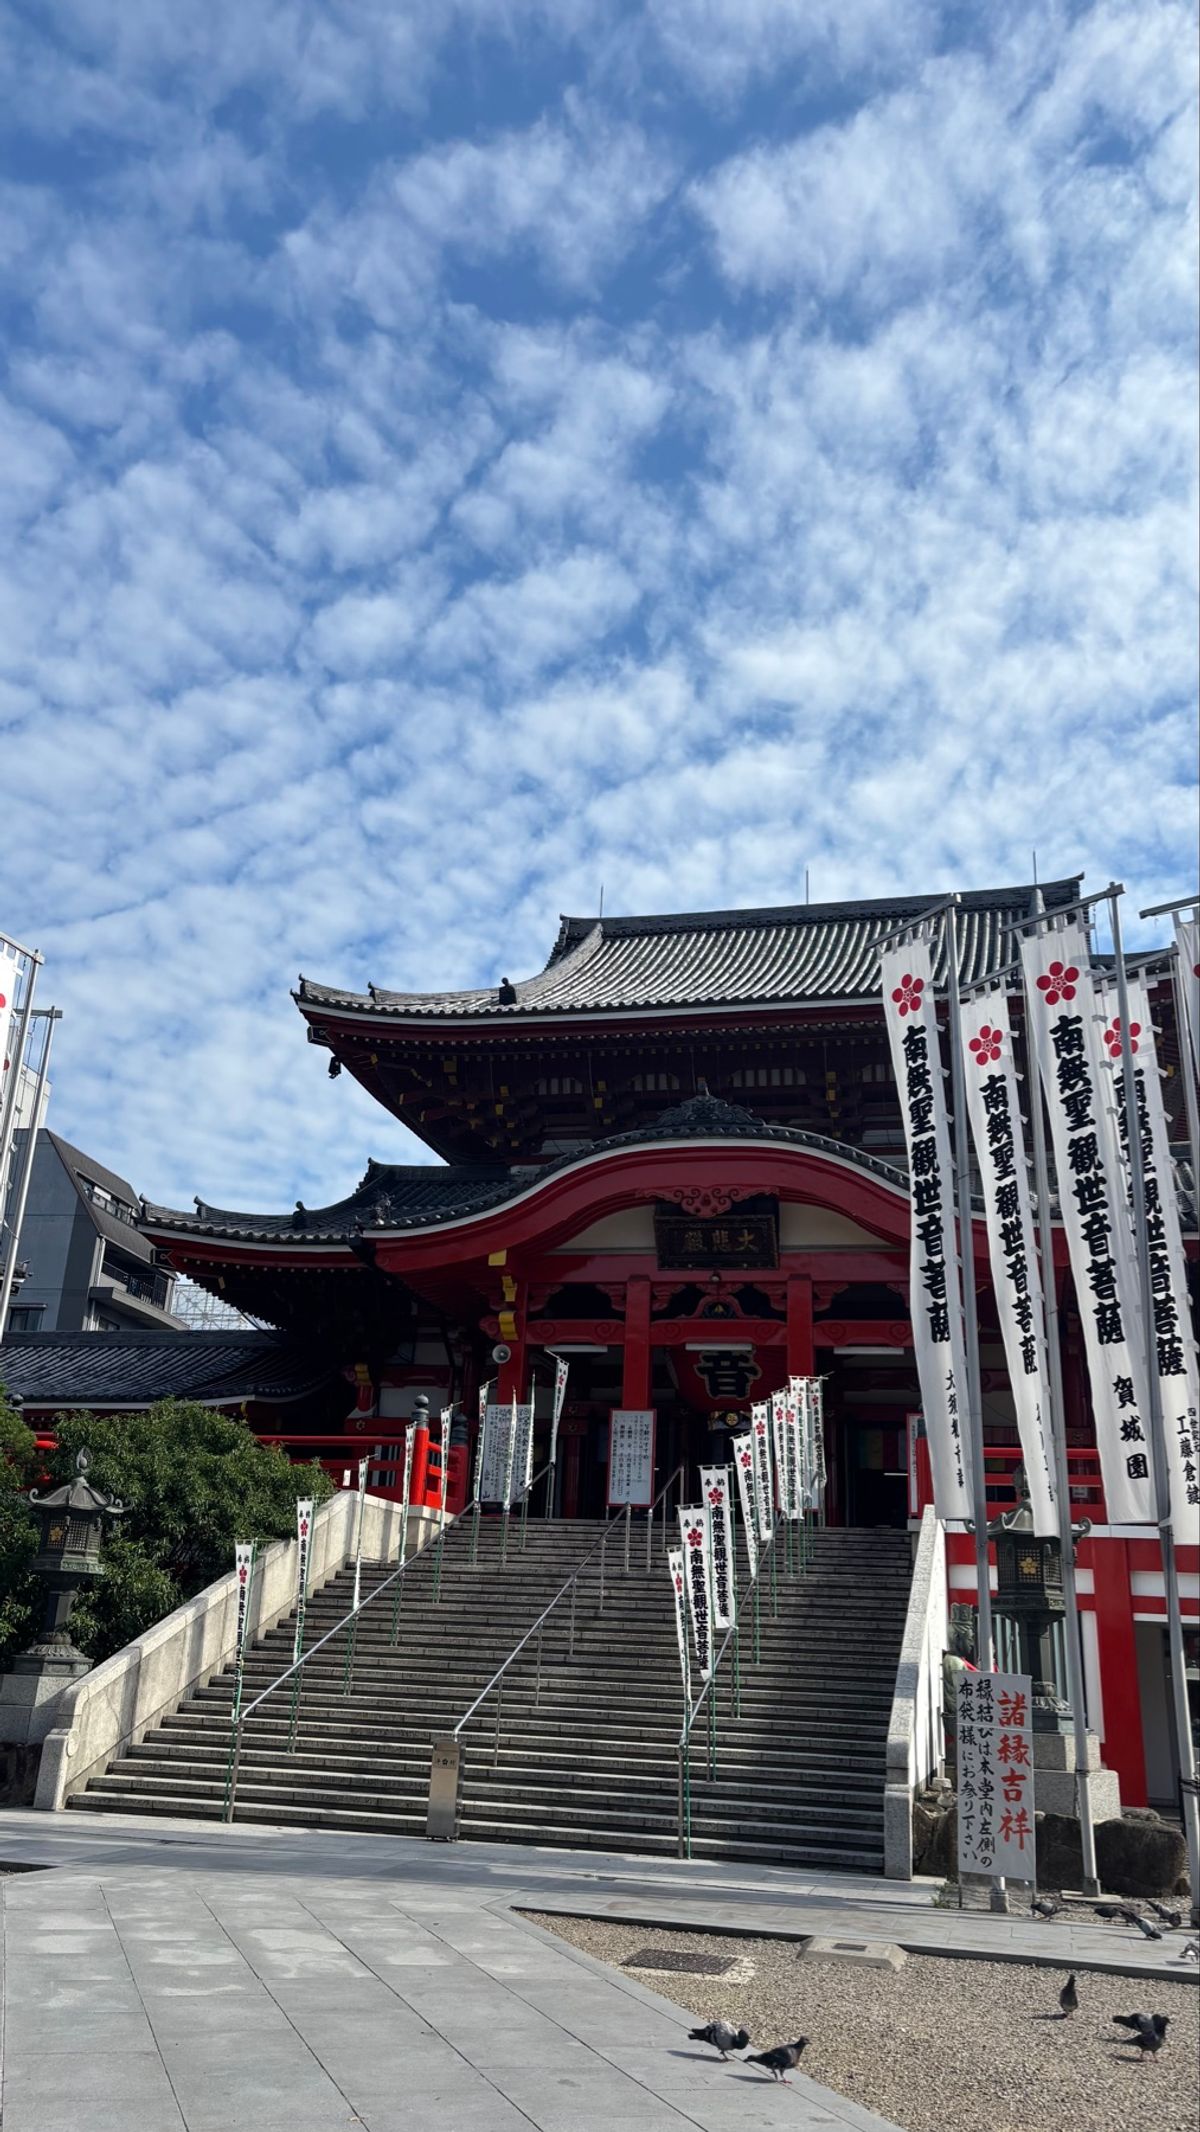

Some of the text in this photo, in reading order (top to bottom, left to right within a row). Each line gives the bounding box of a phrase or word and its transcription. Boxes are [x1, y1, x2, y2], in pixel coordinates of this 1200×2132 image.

[1112, 1374, 1149, 1480] 賀城園
[958, 1677, 978, 1861] 布袋様にお参り下さい
[975, 1678, 996, 1868] 縁結びは本堂内左側の
[997, 1689, 1034, 1851] 諸縁吉祥
